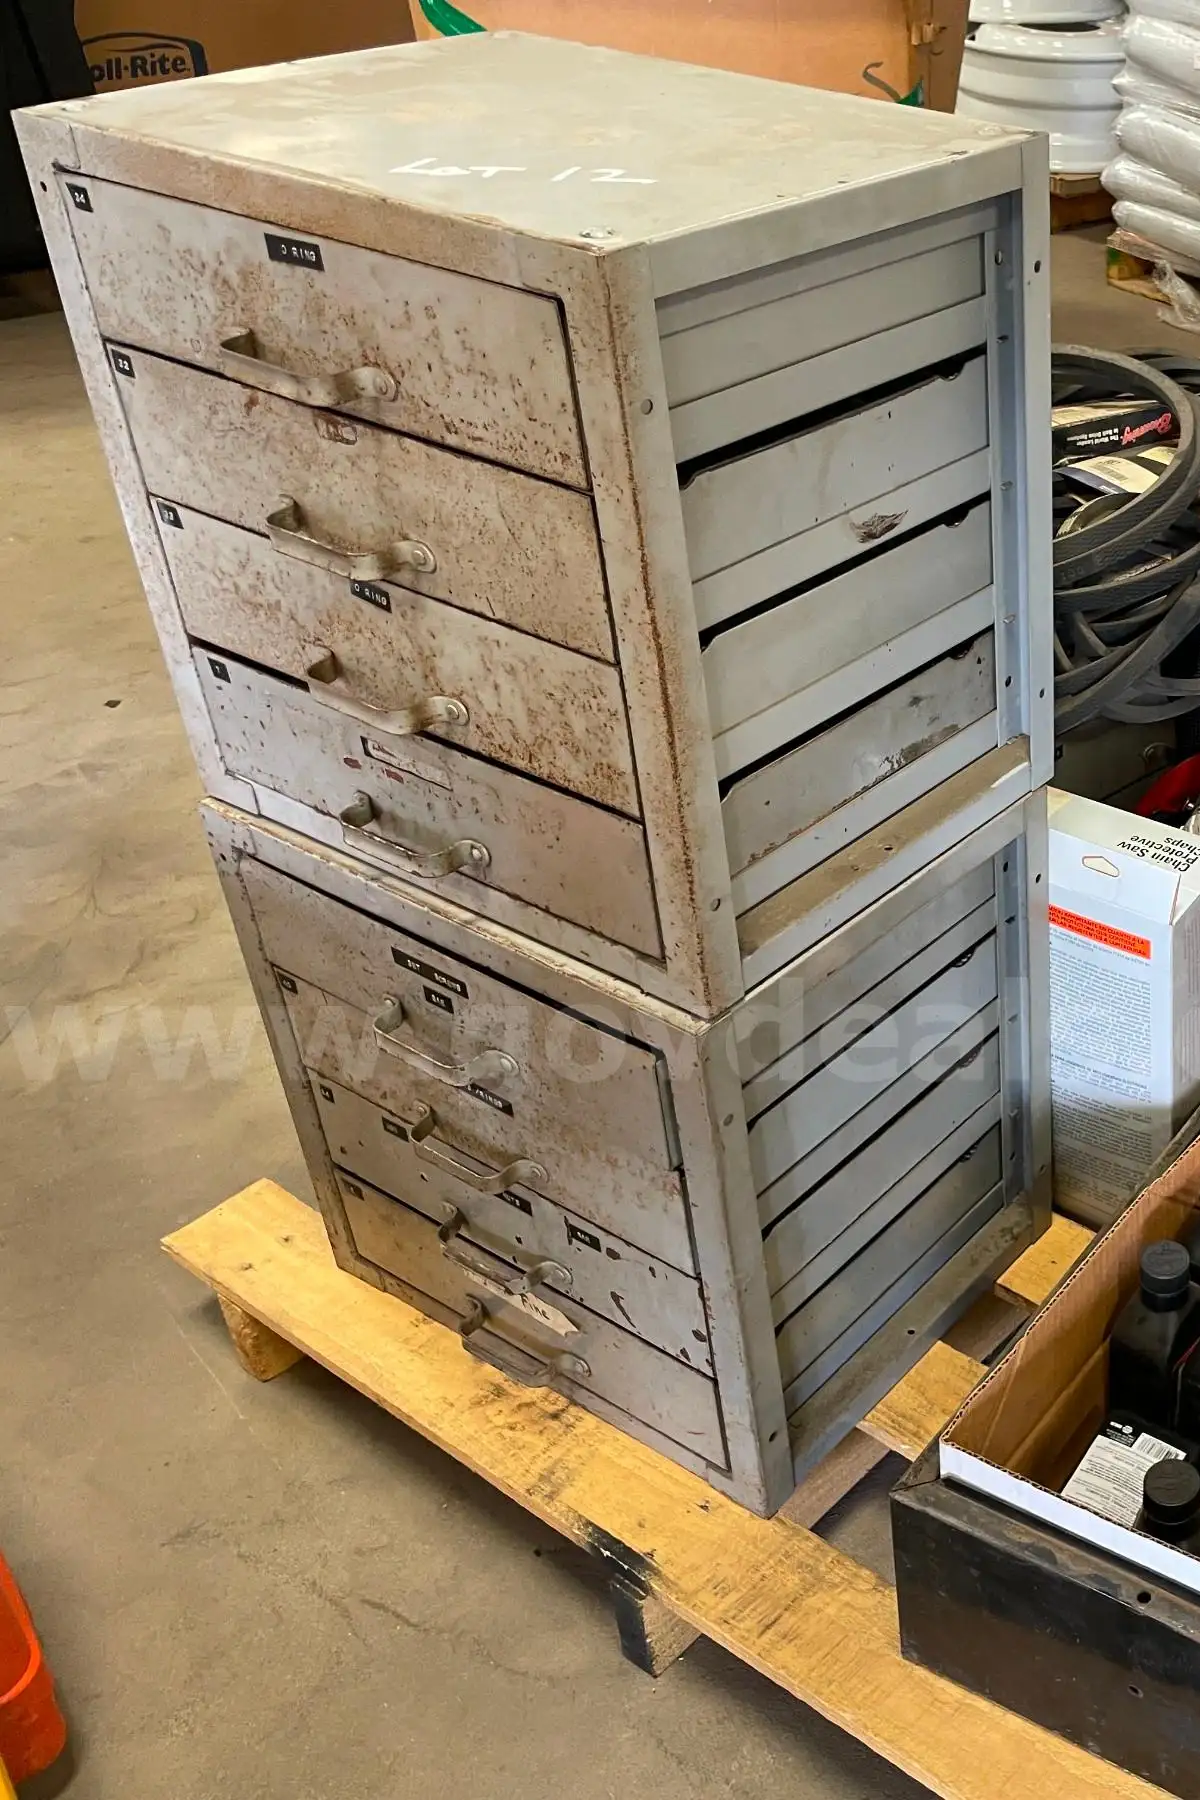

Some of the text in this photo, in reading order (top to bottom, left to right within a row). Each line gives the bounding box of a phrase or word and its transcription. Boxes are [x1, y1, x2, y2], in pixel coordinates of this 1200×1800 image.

[550, 165, 660, 185] 12
[291, 246, 317, 262] RING
[364, 588, 387, 606] RING
[1117, 841, 1191, 872] Chain Saw
[1130, 835, 1199, 865] Protective
